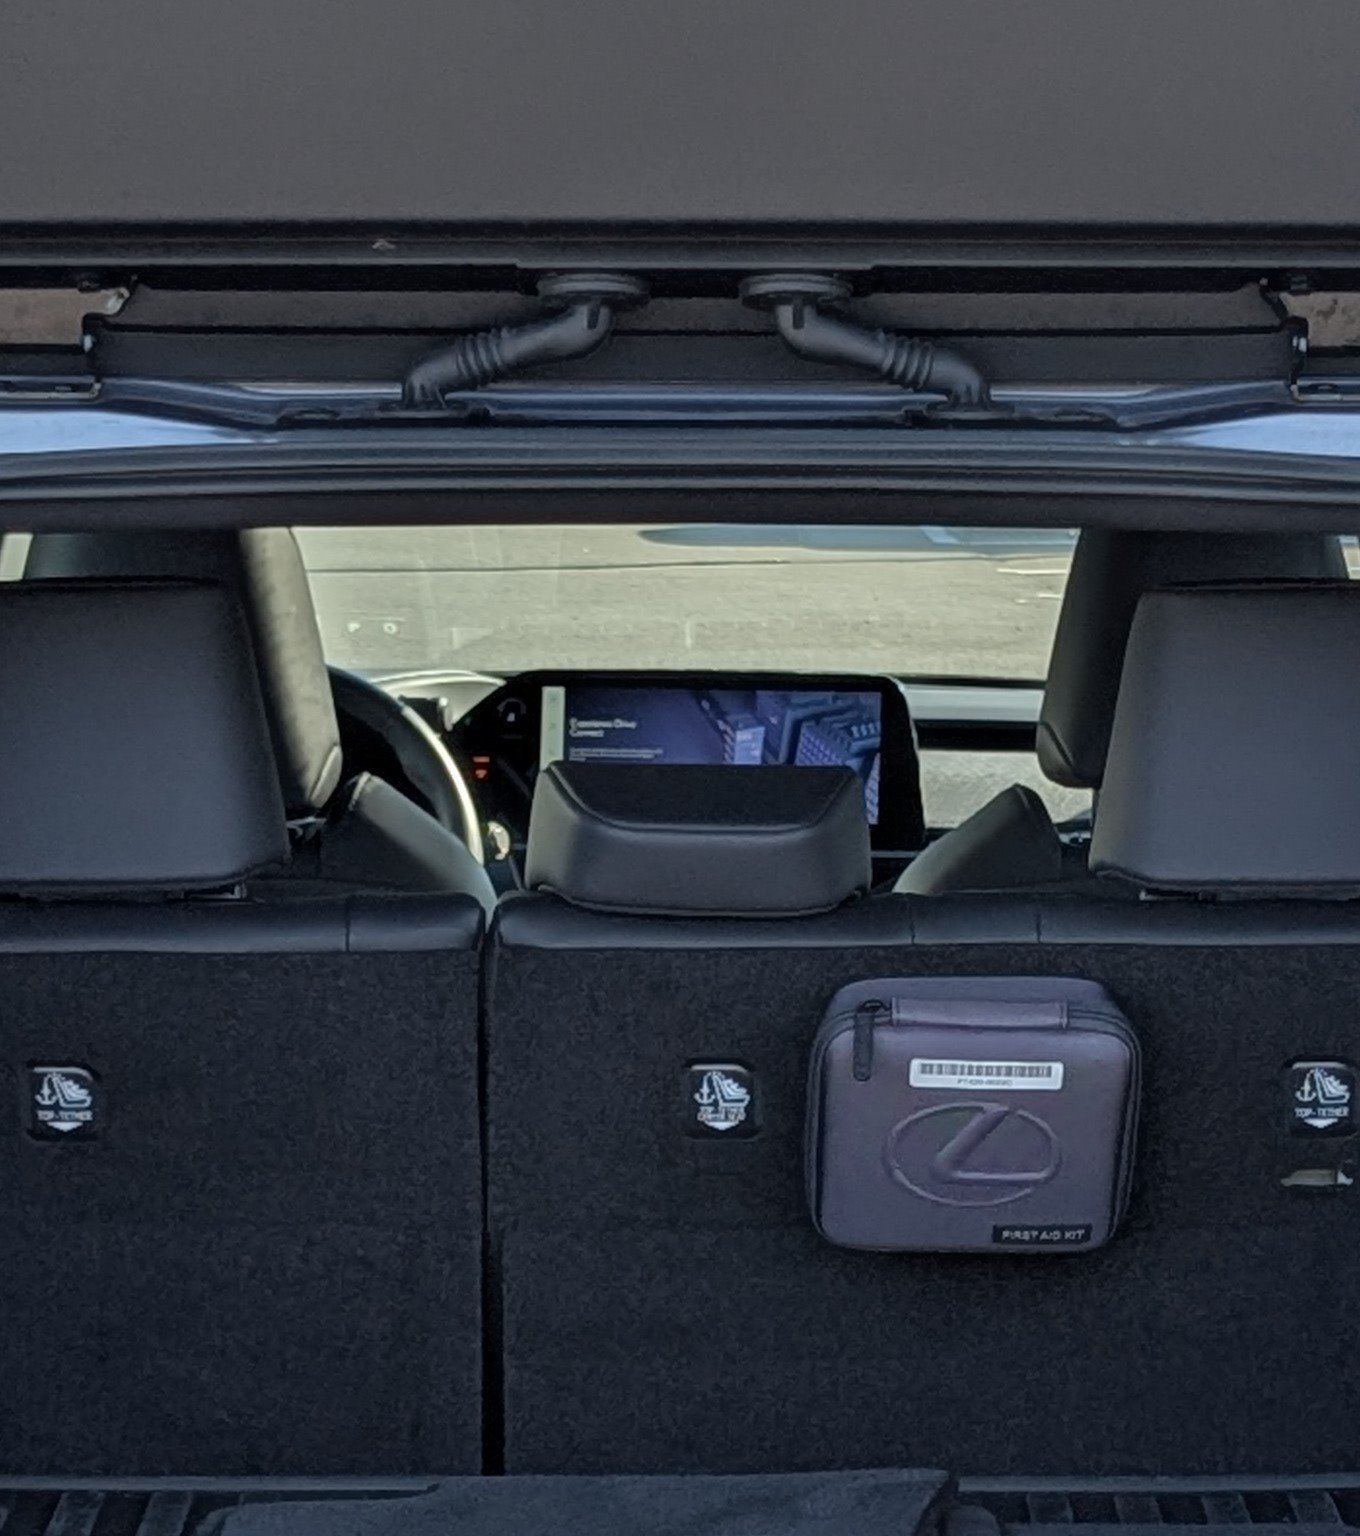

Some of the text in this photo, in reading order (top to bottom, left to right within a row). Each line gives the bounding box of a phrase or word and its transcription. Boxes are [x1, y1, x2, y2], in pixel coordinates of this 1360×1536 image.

[1002, 1229, 1085, 1241] FIRST AID KIT
